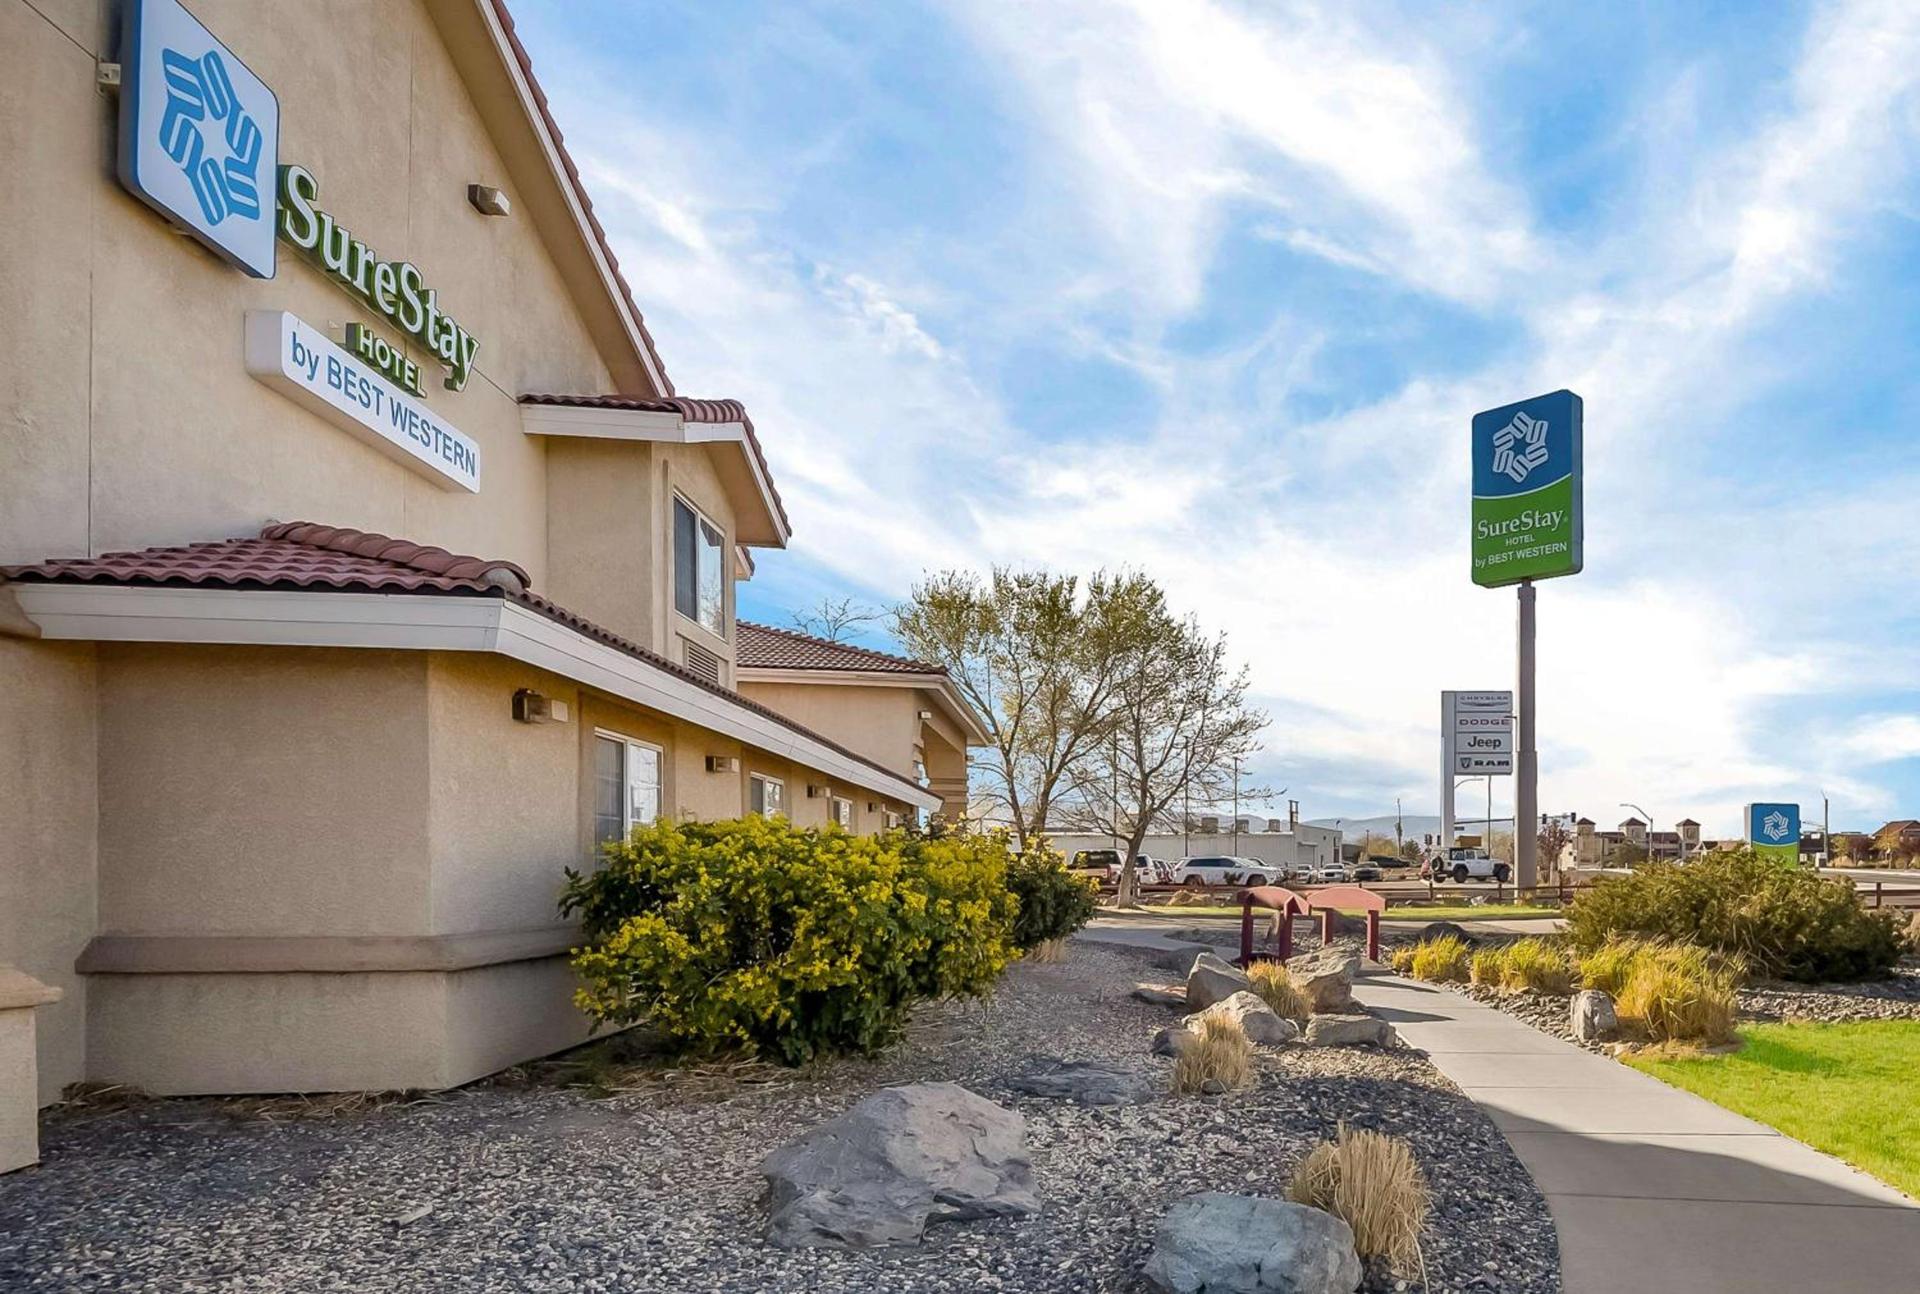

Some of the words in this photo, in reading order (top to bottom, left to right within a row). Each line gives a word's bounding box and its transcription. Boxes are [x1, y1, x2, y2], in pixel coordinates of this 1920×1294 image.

[280, 164, 480, 391] SureStay
[352, 324, 427, 398] HOTEL
[291, 331, 320, 381] by
[327, 353, 385, 417] BEST
[390, 396, 477, 478] WESTERN
[1477, 510, 1564, 540] SureStay
[1505, 534, 1535, 546] HOTEL
[1475, 557, 1487, 569] by
[1488, 551, 1515, 565] BEST
[1516, 542, 1567, 559] WESTERN
[1468, 736, 1501, 749] Jeep
